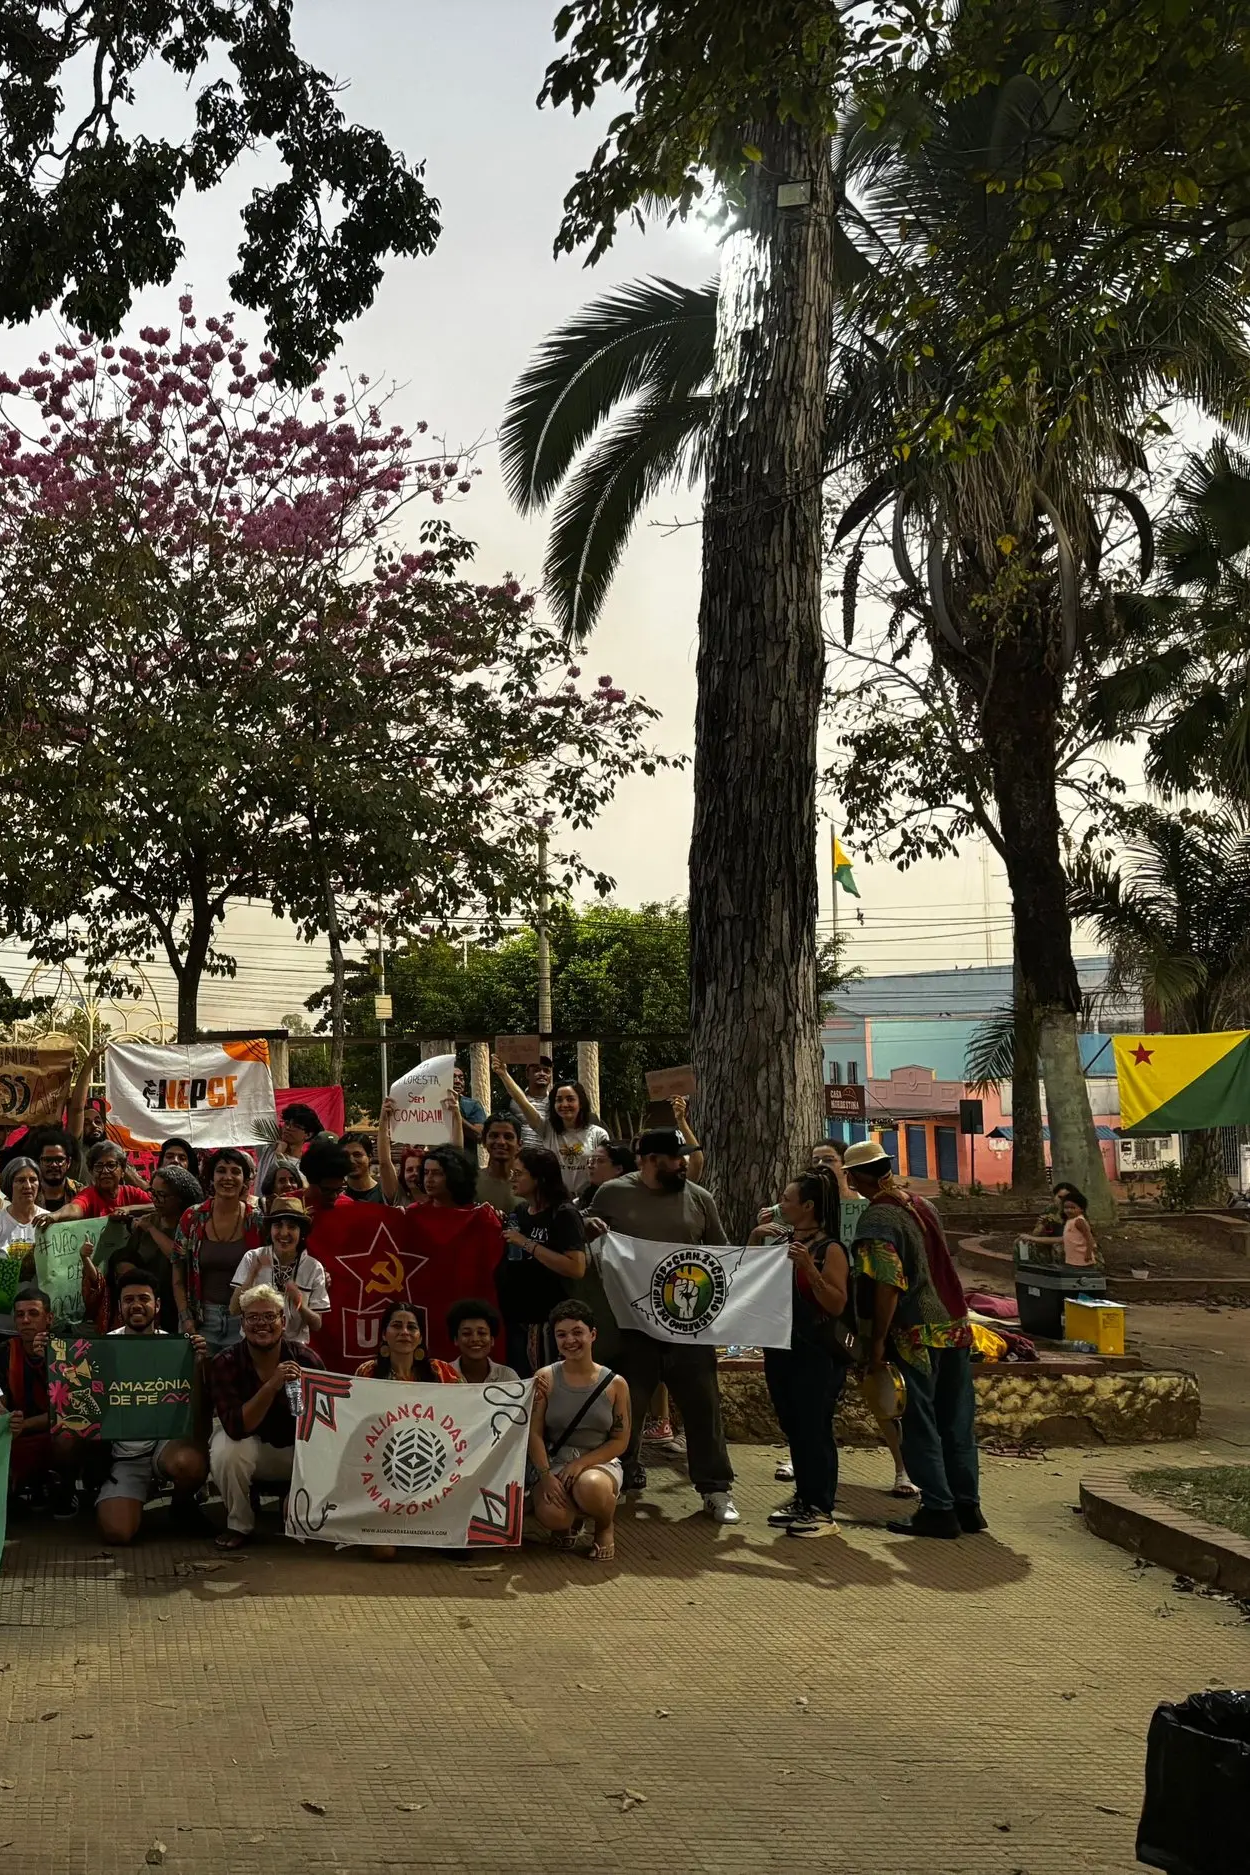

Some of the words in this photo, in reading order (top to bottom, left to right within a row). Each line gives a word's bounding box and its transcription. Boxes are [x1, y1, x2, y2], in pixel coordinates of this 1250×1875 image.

[158, 1075, 238, 1109] NEPSE
[653, 1266, 667, 1288] HOP
[710, 1266, 724, 1312] CENTRO
[653, 1289, 662, 1309] HIP
[108, 1377, 192, 1393] AMAZÔNIA
[109, 1394, 131, 1406] DE
[136, 1391, 159, 1406] PÉ
[365, 1403, 435, 1448] ALIANÇA
[439, 1414, 468, 1453] DAS
[360, 1472, 462, 1516] AMAZÔNIAS
